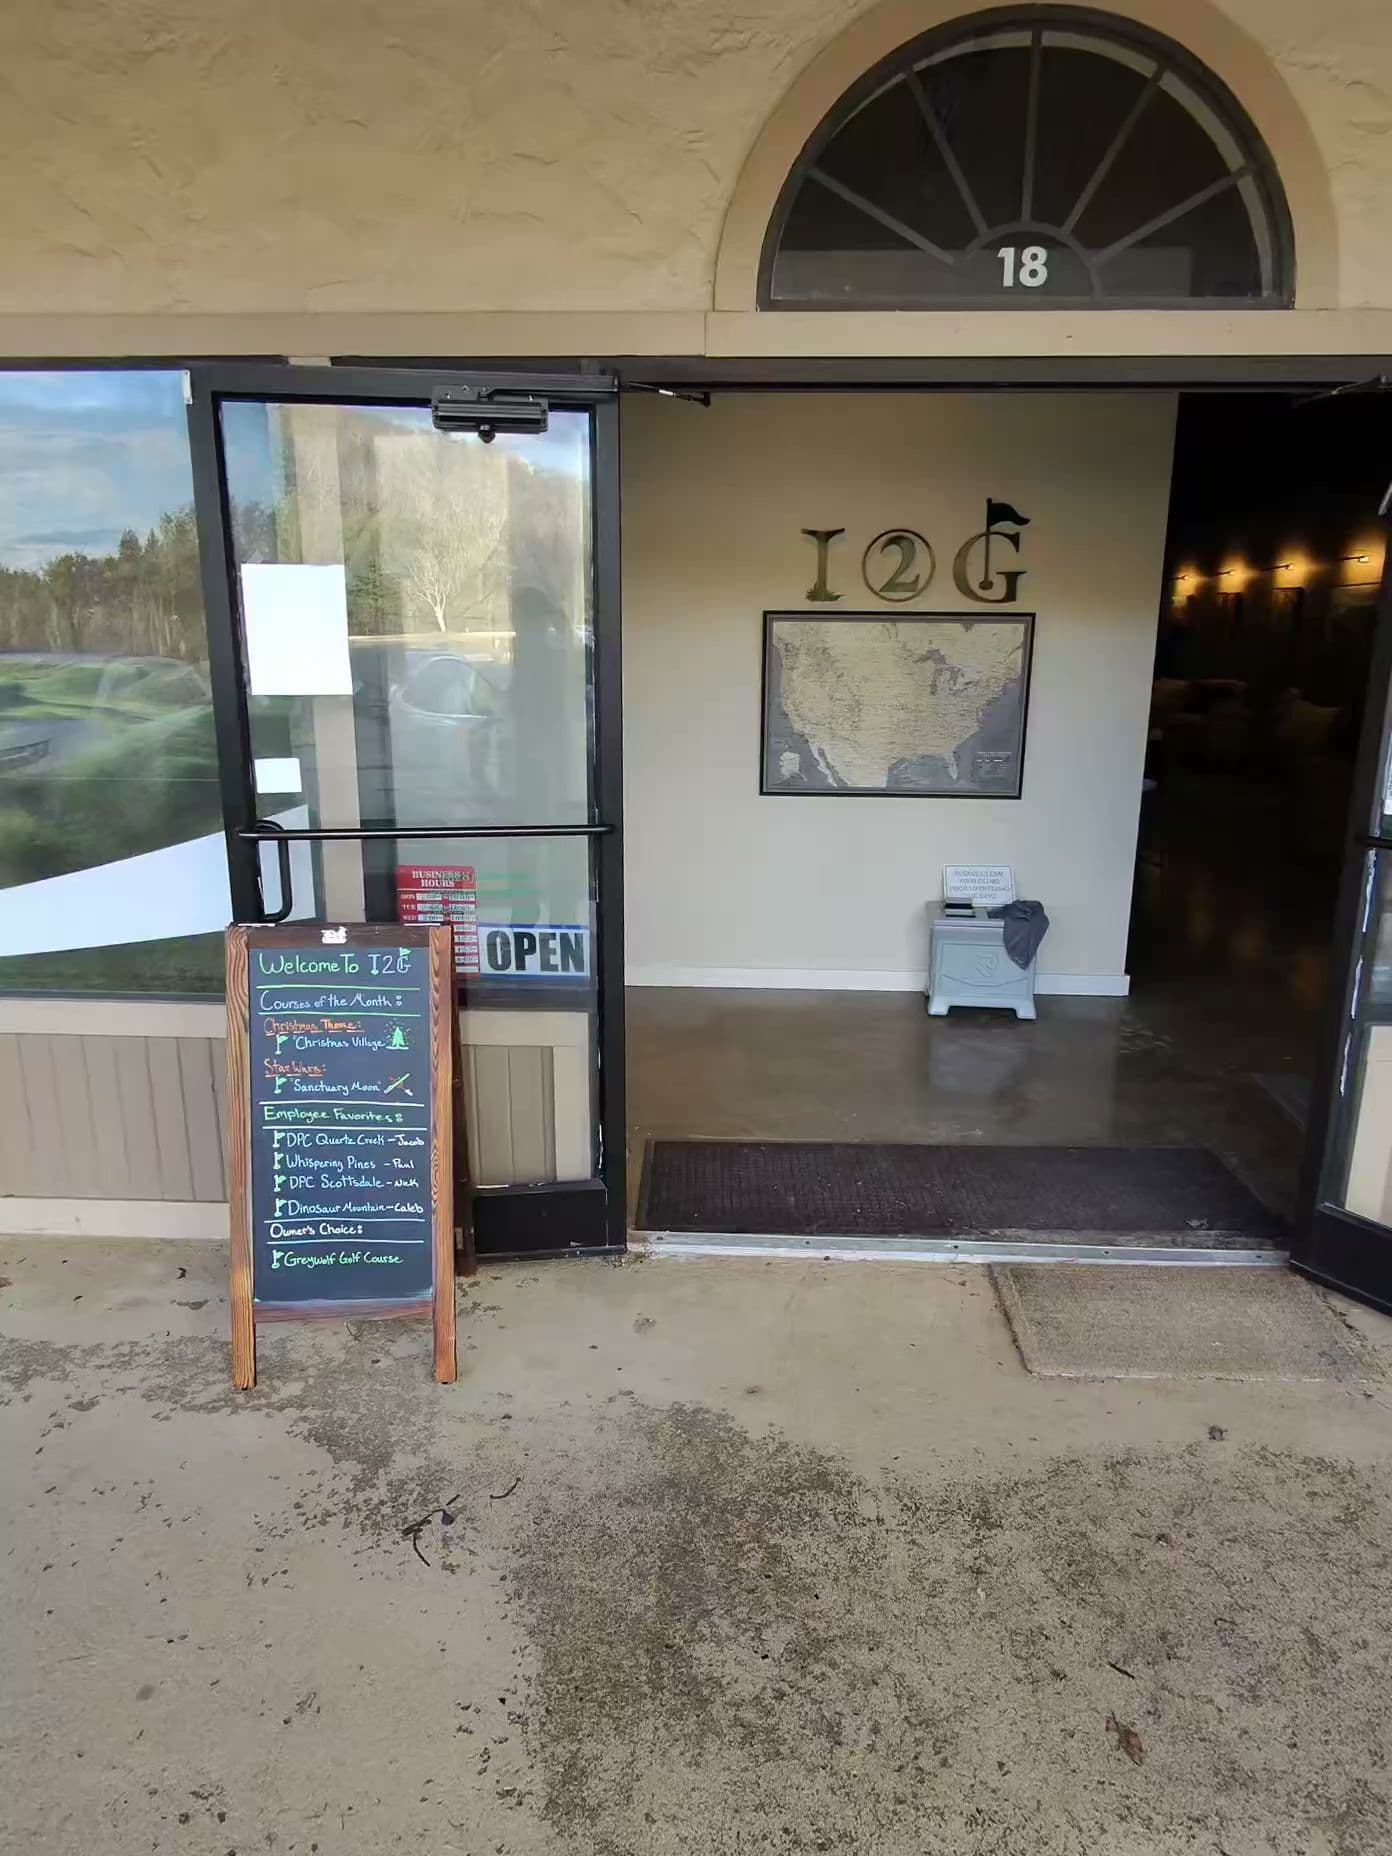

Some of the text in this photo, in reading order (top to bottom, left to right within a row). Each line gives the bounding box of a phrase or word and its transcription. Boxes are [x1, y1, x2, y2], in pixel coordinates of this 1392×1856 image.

[997, 246, 1048, 287] 18
[801, 525, 1028, 604] I2G
[421, 879, 455, 888] HOURS
[486, 929, 585, 973] OPEN
[259, 950, 411, 975] Welcome To I2G
[260, 990, 311, 1011] Courses
[314, 996, 326, 1008] of
[327, 994, 348, 1007] the
[264, 1017, 318, 1034] Christmas
[264, 1106, 403, 1123] Employee Favorites:
[287, 1132, 312, 1148] DPC
[316, 1133, 356, 1146] Quartz
[286, 1154, 344, 1173] Whispering
[347, 1155, 376, 1170] Pines
[289, 1175, 315, 1189] DPC
[321, 1173, 384, 1189] Scottsdale
[287, 1199, 341, 1216] Dinosaur
[319, 1222, 363, 1235] Choice:
[284, 1251, 403, 1268] Greywolf Golf Course
